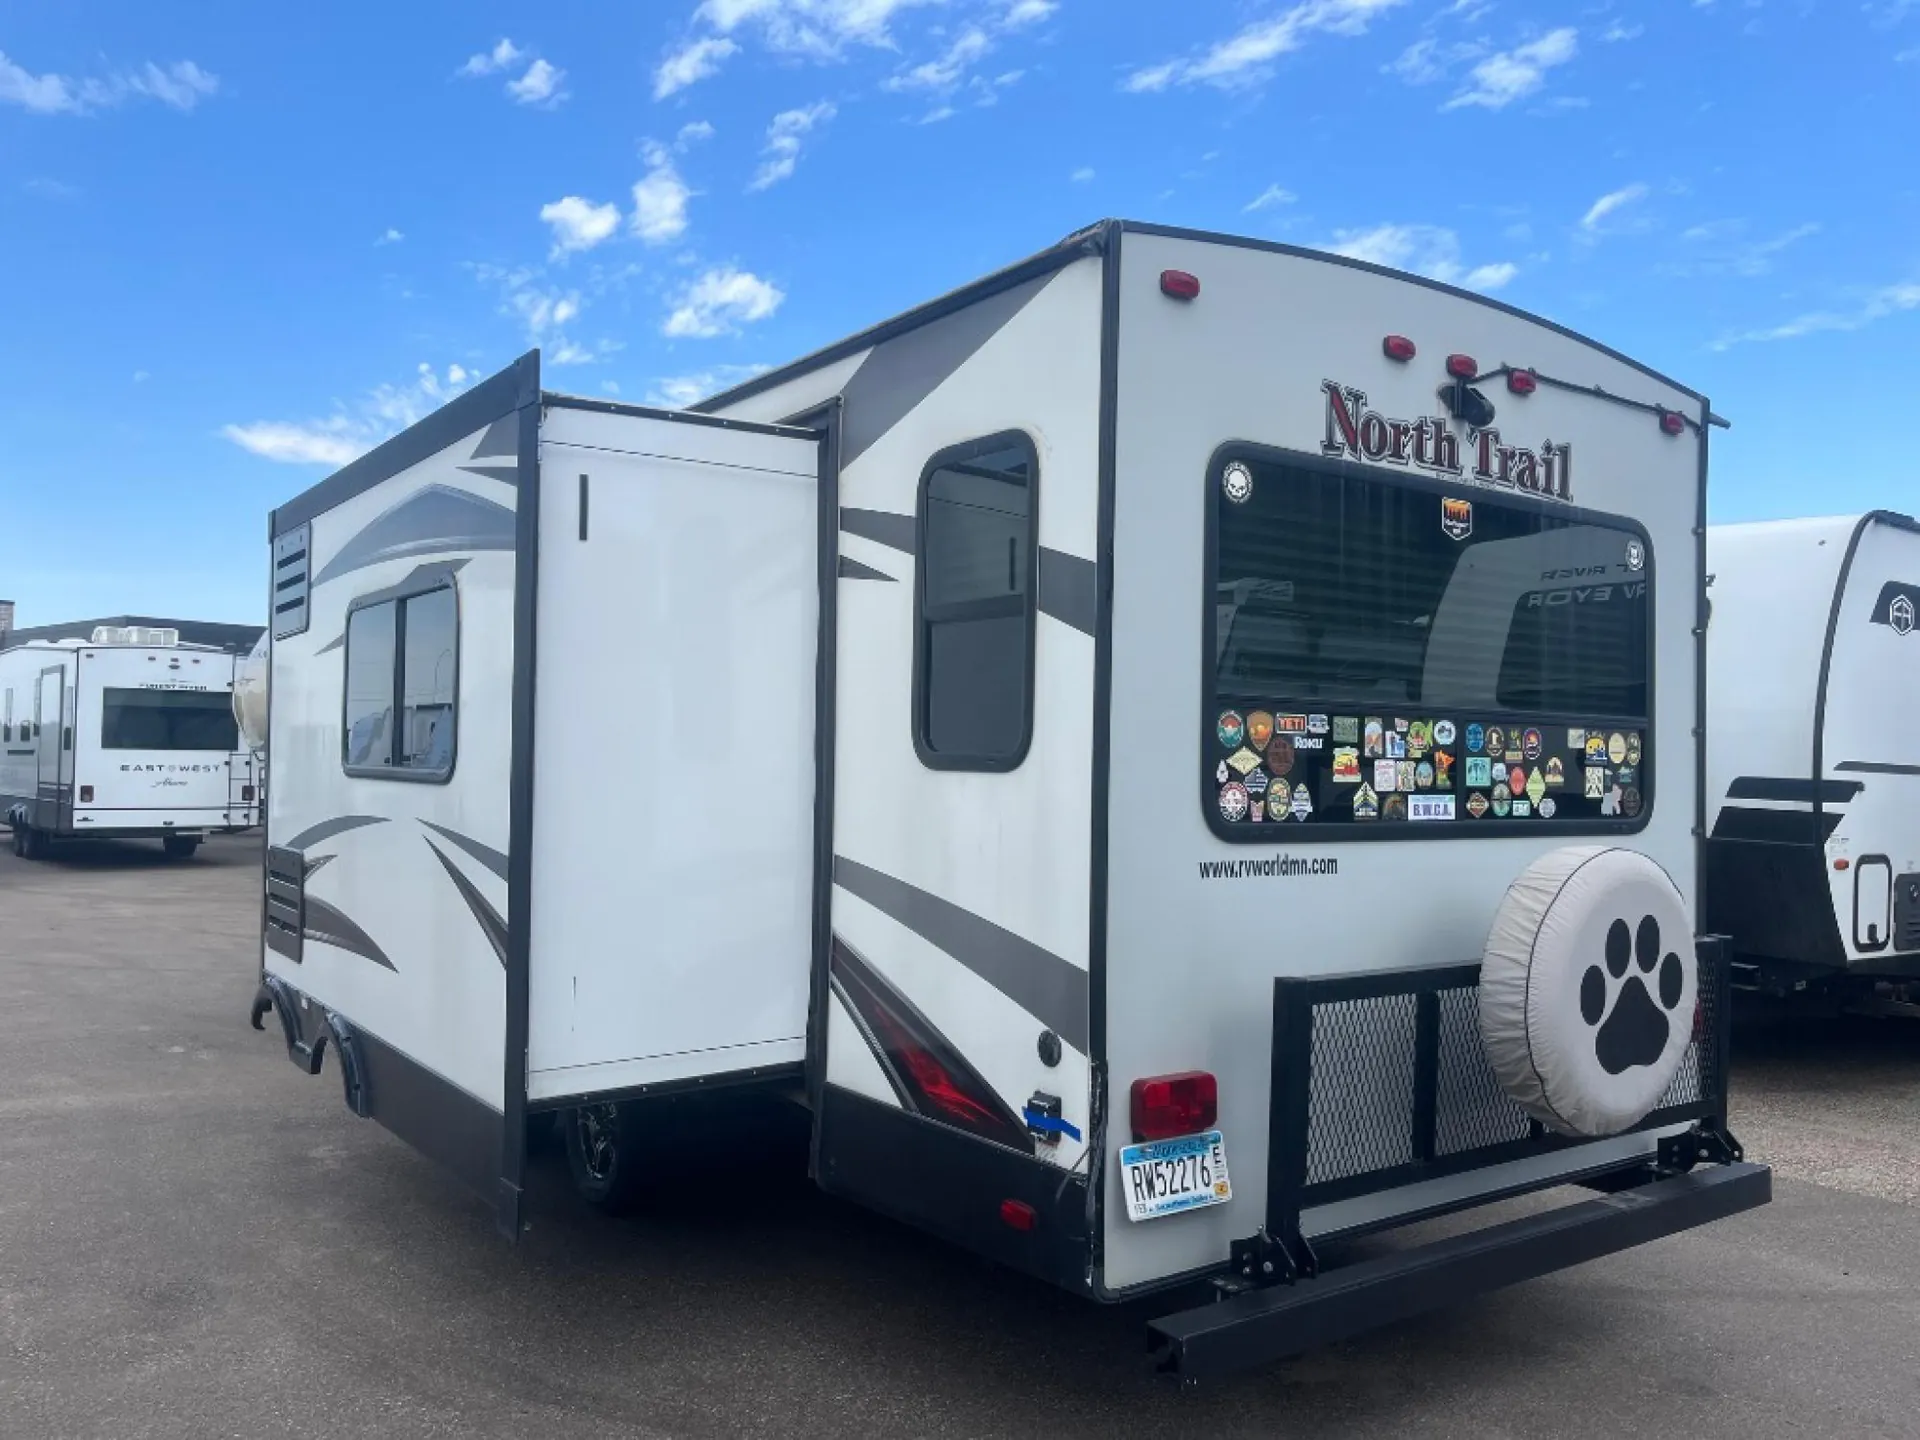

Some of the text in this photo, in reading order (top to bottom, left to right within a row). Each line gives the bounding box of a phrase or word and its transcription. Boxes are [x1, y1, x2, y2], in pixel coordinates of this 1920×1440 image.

[1320, 378, 1574, 504] North Trail
[1278, 717, 1304, 731] YETI
[119, 764, 220, 773] EAST WEST
[1198, 852, 1338, 879] www.rvworldmn.com
[1131, 1154, 1212, 1203] RW52276
